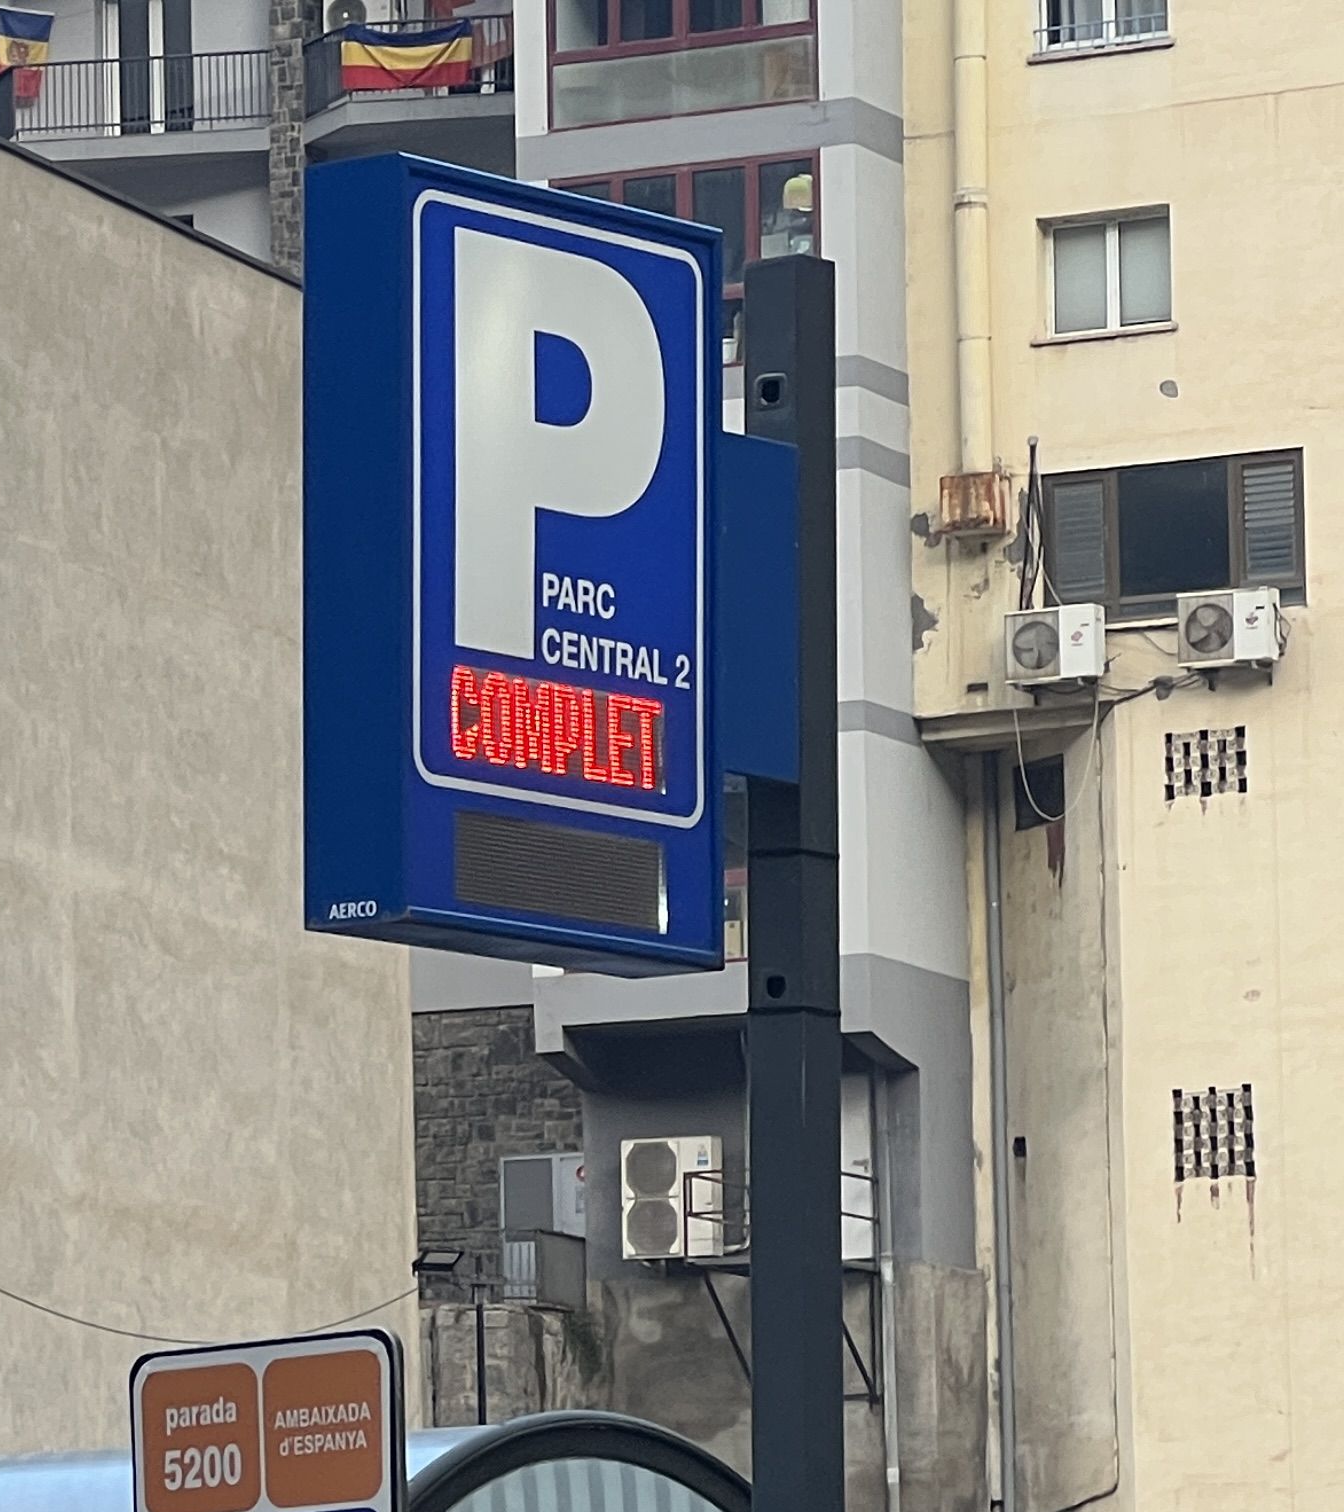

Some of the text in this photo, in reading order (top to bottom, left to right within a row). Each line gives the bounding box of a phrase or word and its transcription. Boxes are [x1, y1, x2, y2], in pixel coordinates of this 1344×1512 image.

[455, 226, 666, 661] P
[542, 572, 616, 621] PARC
[542, 628, 690, 690] CENTRAL 2
[450, 665, 663, 790] COMPLET
[329, 900, 377, 920] AERCO
[166, 1396, 237, 1435] parada
[274, 1401, 371, 1430] AMBAIXADA
[164, 1443, 242, 1491] 5200
[279, 1429, 367, 1457] d'ESPANYA
